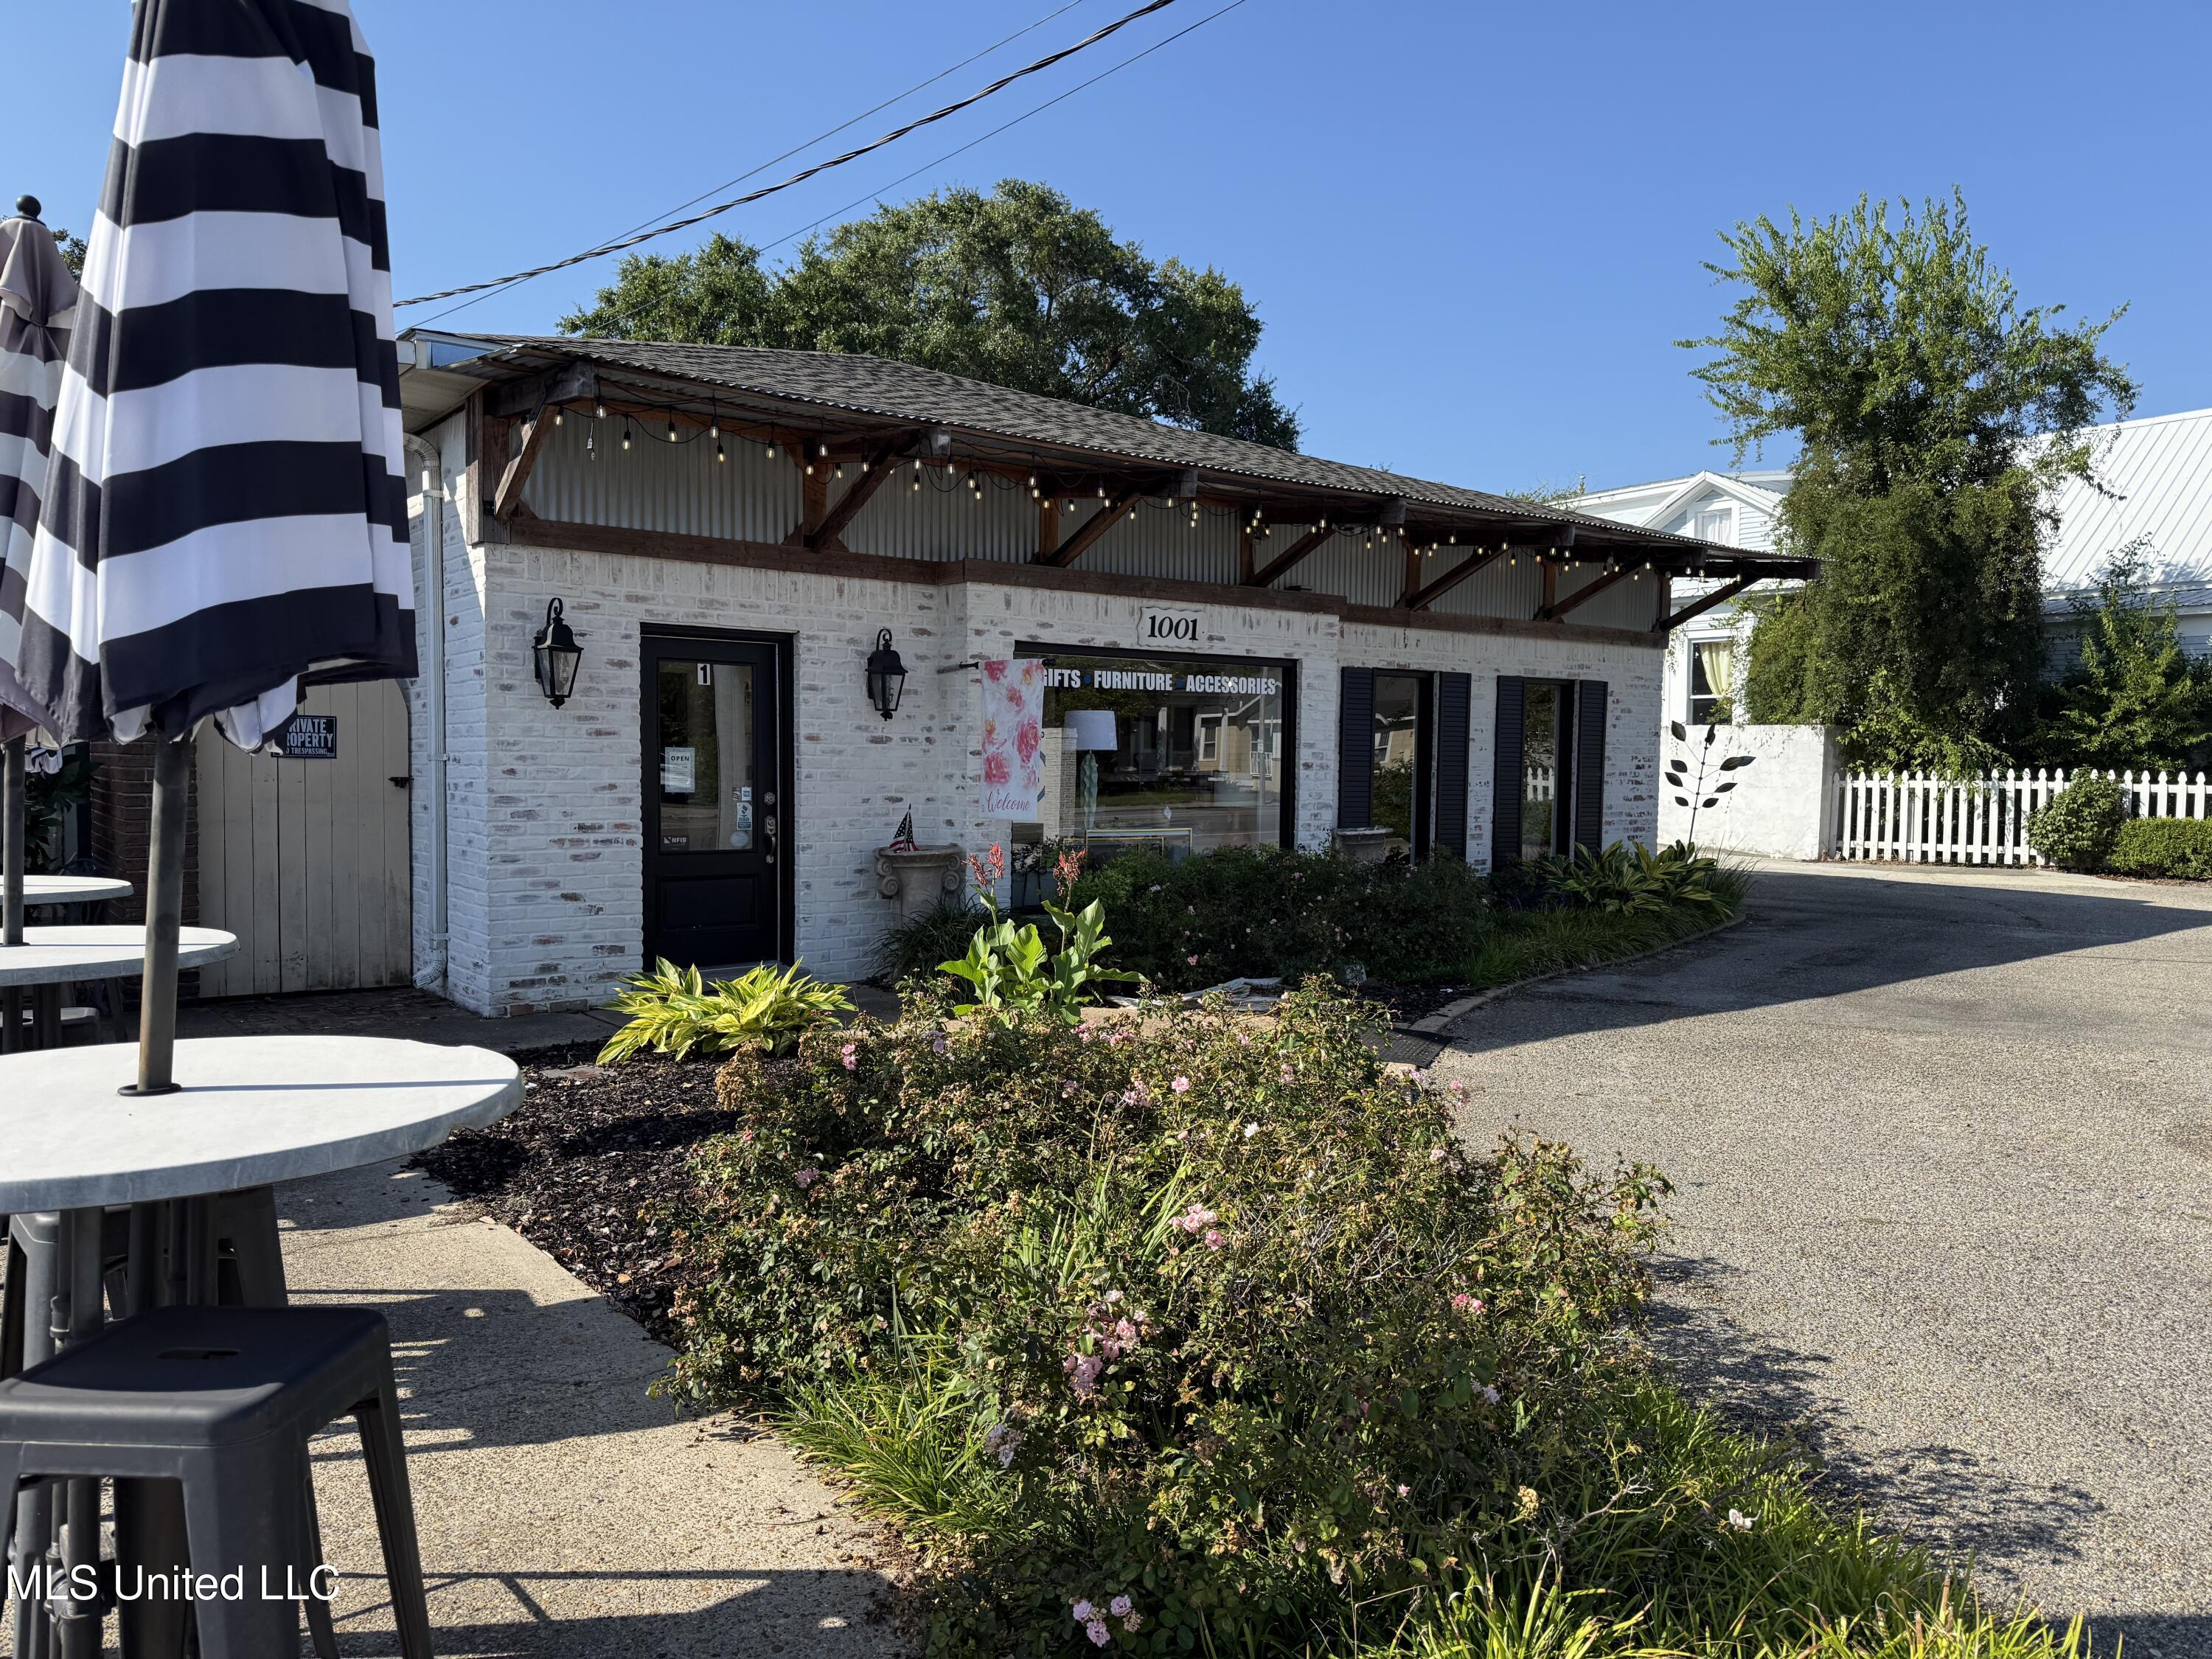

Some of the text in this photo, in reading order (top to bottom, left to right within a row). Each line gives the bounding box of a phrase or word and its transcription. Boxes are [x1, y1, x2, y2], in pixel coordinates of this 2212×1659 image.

[1147, 615, 1198, 641] 1001
[700, 664, 708, 684] 1
[1093, 670, 1173, 691] FURNITURE
[1186, 675, 1276, 695] ACCESSORIES
[289, 718, 327, 733] RIVATE
[286, 732, 333, 748] OPERTY
[291, 747, 327, 755] TRESPASSING
[985, 787, 1030, 813] Welcome
